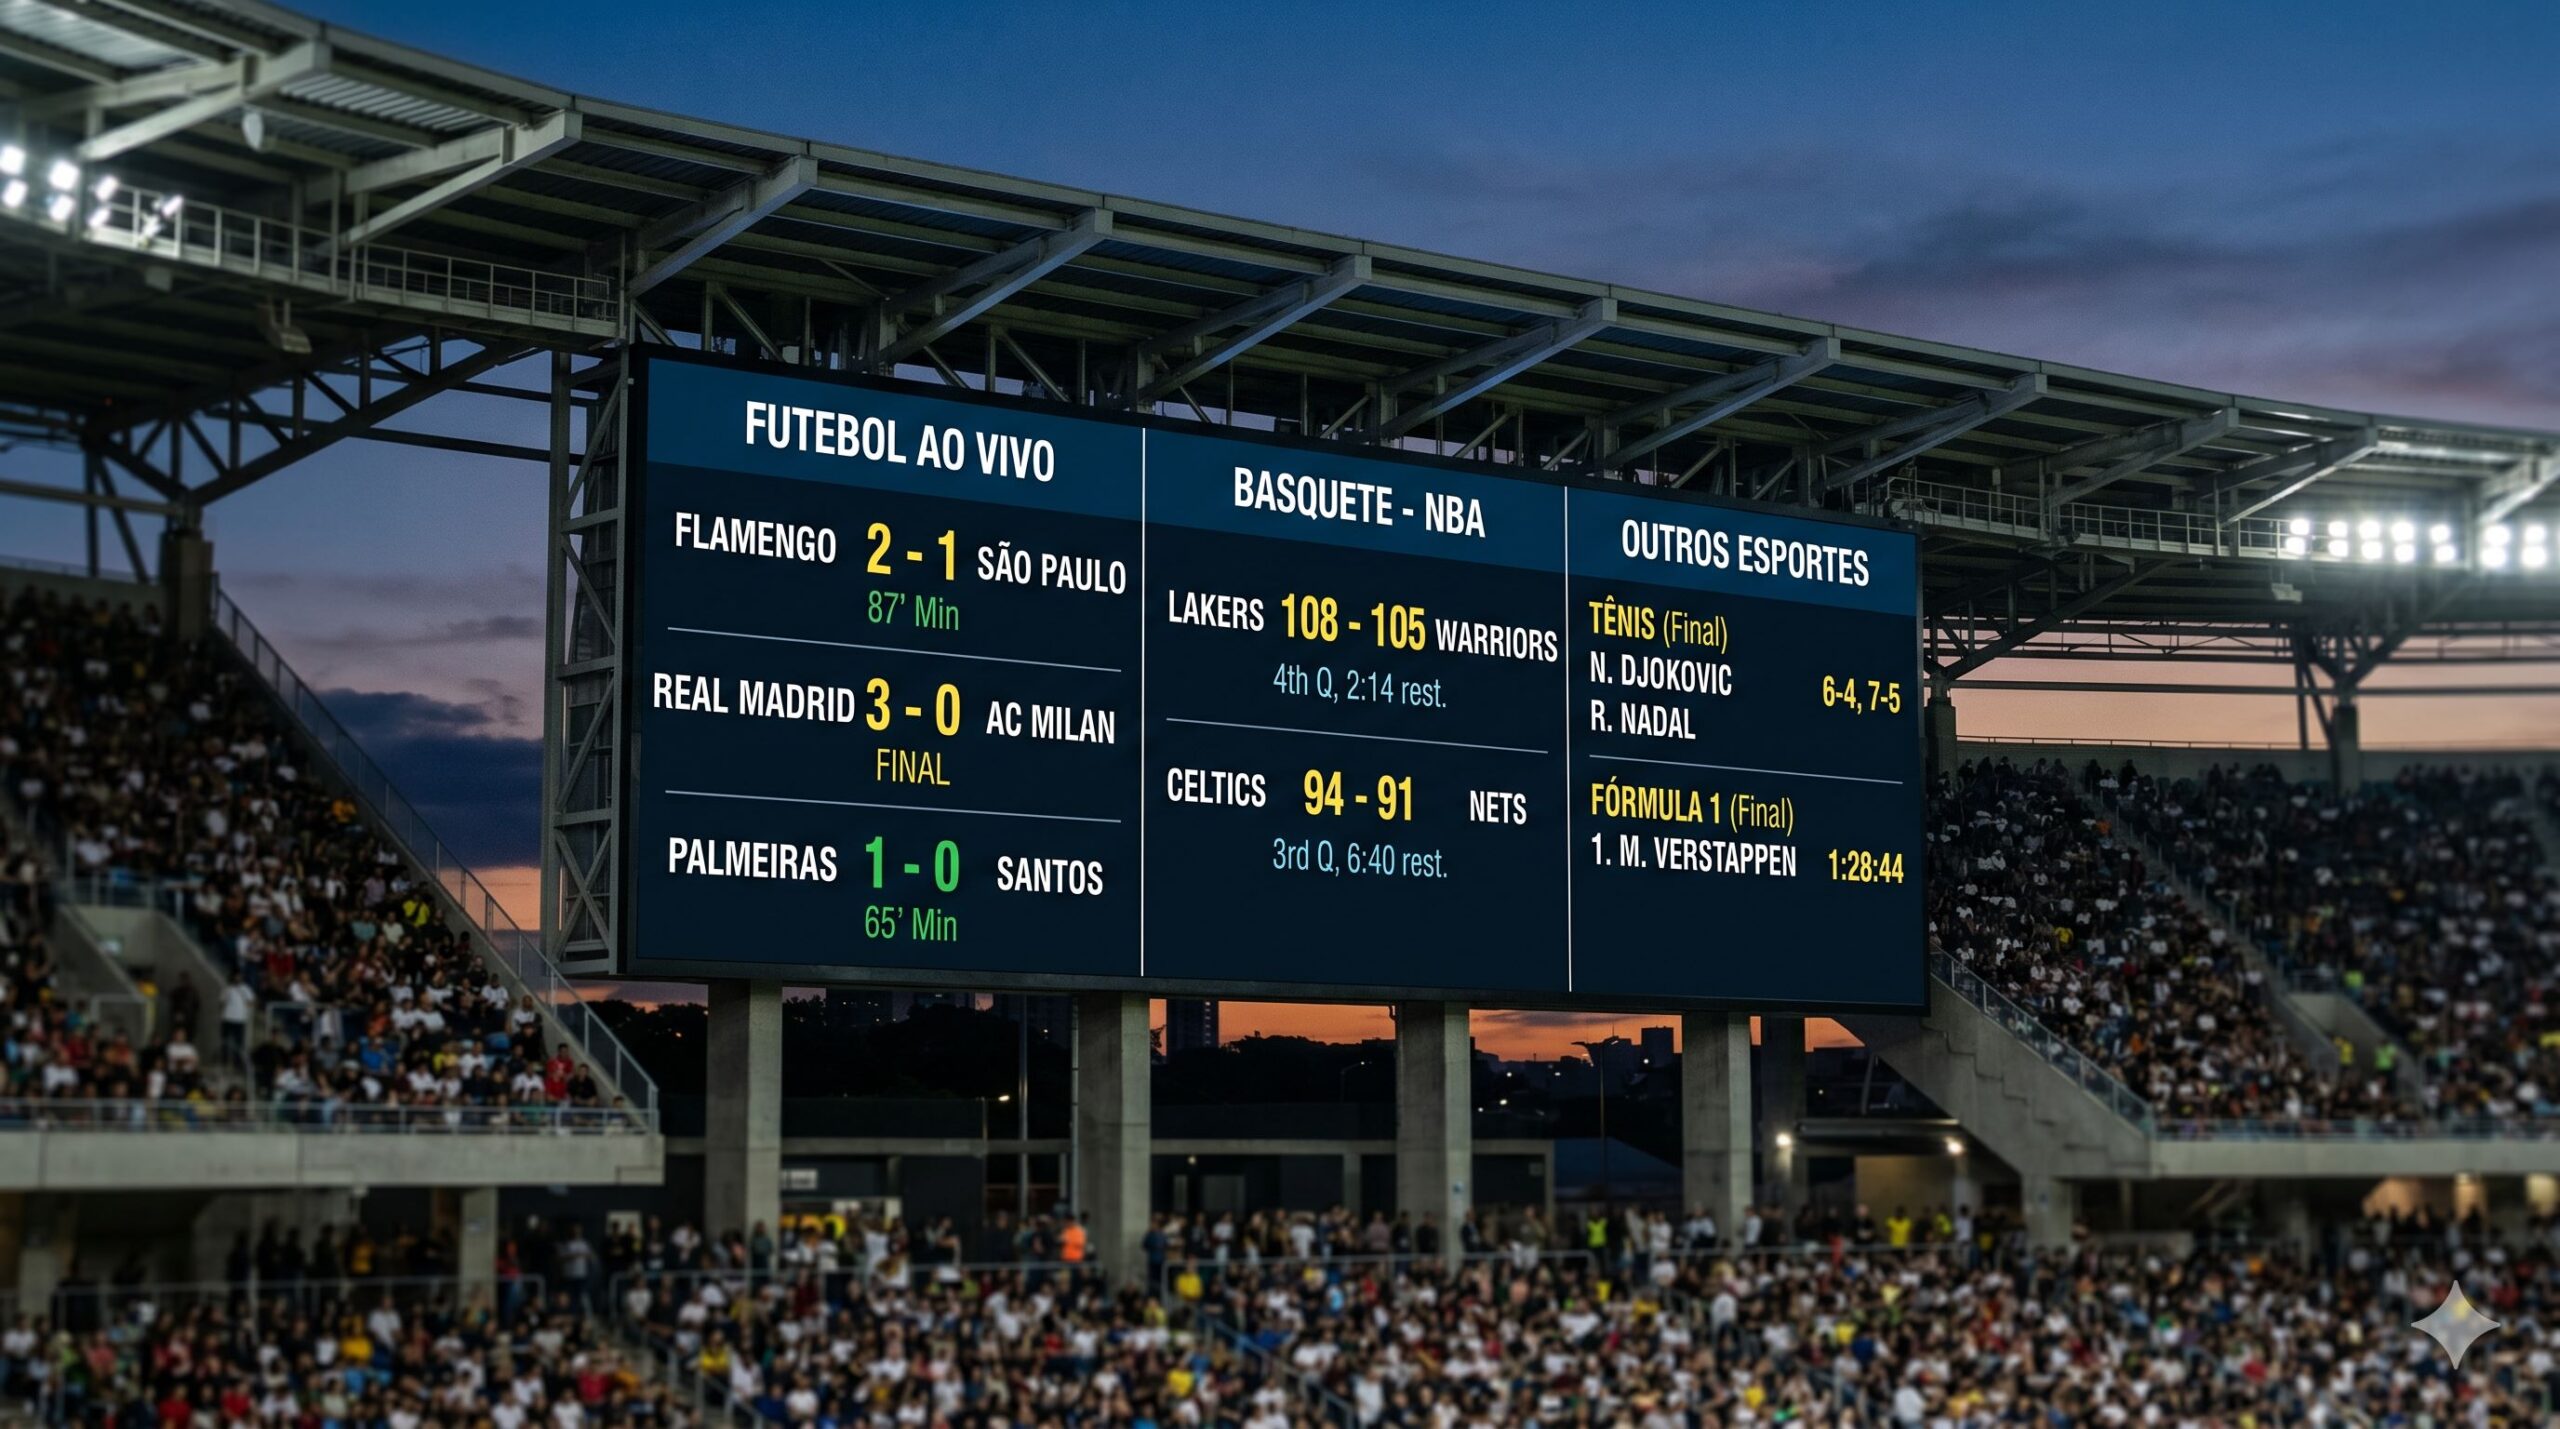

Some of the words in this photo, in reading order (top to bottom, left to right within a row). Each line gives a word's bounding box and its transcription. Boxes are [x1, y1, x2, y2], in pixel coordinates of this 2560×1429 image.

[746, 400, 907, 464] FUTEBOL
[916, 424, 965, 471] AO
[975, 431, 1055, 482] VIVO
[1234, 466, 1393, 526] BASQUETE
[1402, 507, 1414, 517] -
[1425, 491, 1486, 538] NBA
[675, 511, 837, 564] FLAMENGO
[867, 522, 892, 575] 2
[906, 550, 923, 562] -
[938, 529, 955, 581] 1
[977, 540, 1032, 585] SÃO
[1041, 553, 1127, 595] PAULO
[1622, 519, 1730, 569] OUTROS
[1738, 534, 1870, 587] ESPORTES
[915, 594, 959, 631] Min
[1169, 589, 1265, 632] LAKERS
[1281, 593, 1339, 642] 108
[1348, 621, 1361, 631] -
[1371, 602, 1426, 651] 105
[1435, 618, 1558, 663] WARRIORS
[1588, 594, 1655, 640] TÊNIS
[1663, 610, 1728, 655] (Final)
[1273, 662, 1308, 696] 4th
[1316, 666, 1338, 704] Q,
[1347, 669, 1394, 704] 2:14
[1401, 678, 1447, 708] rest.
[1590, 650, 1613, 684] N.
[1621, 653, 1732, 696] DJOKOVIC
[1822, 675, 1862, 715] 6-4,
[1867, 680, 1901, 714] 7-5
[653, 672, 729, 714] REAL
[739, 679, 855, 723] MADRID
[865, 677, 891, 731] 3
[905, 706, 922, 717] -
[935, 683, 961, 736] 0
[985, 700, 1022, 737] AC
[1031, 704, 1115, 745] MILAN
[1590, 699, 1613, 732] R.
[1621, 702, 1696, 740] NADAL
[877, 748, 951, 786] FINAL
[1167, 767, 1267, 808] CELTICS
[1303, 769, 1345, 816] 94
[1355, 794, 1368, 804] -
[1377, 774, 1412, 821] 91
[1469, 790, 1527, 825] NETS
[1591, 775, 1703, 823] FÓRMULA
[1710, 792, 1720, 824] 1
[1730, 793, 1794, 837] (Final)
[669, 836, 838, 882] PALMEIRAS
[865, 835, 883, 889] 1
[904, 863, 920, 874] -
[934, 839, 960, 893] 0
[997, 855, 1104, 896] SANTOS
[1272, 837, 1309, 871] 3rd
[1317, 839, 1340, 877] Q,
[1347, 842, 1395, 876] 6:40
[1402, 849, 1448, 878] rest.
[1591, 832, 1611, 866] 1.
[1619, 834, 1647, 868] M.
[1653, 836, 1797, 877] VERSTAPPEN
[1828, 848, 1904, 884] 1:28:44
[912, 907, 957, 942] Min
